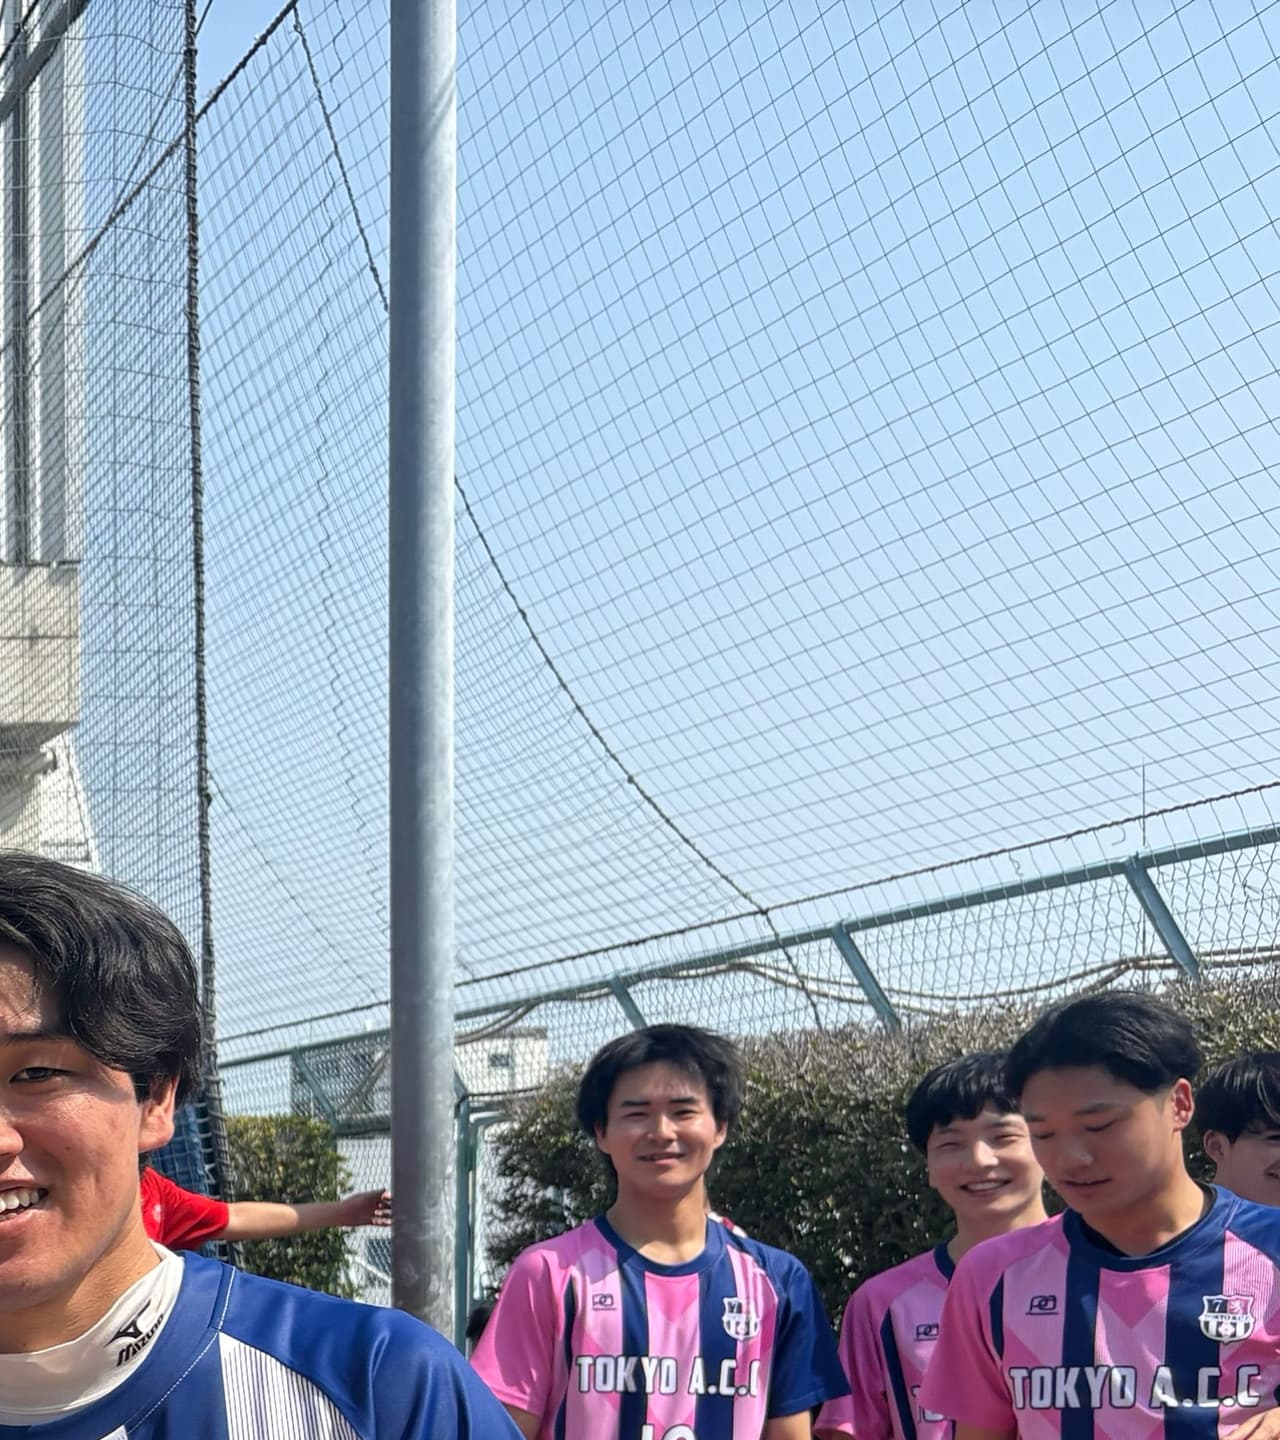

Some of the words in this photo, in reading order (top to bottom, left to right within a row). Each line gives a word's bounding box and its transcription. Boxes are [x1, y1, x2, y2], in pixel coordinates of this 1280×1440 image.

[576, 1355, 678, 1395] TOKYO
[1009, 1365, 1138, 1408] TOKYO
[1150, 1364, 1260, 1408] A.C.C
